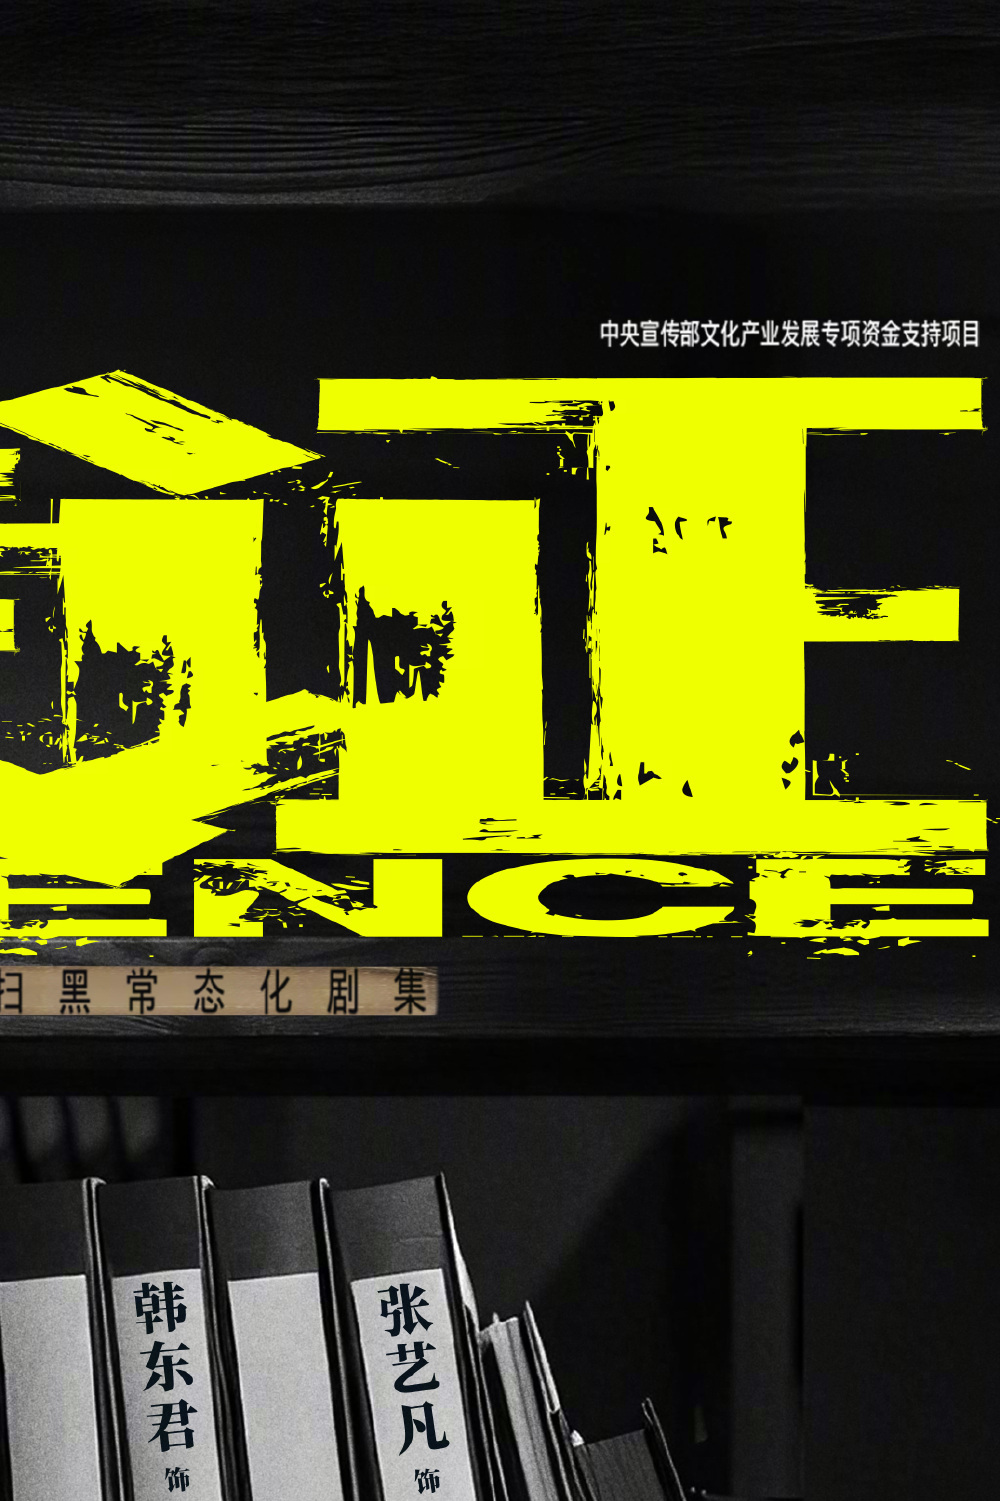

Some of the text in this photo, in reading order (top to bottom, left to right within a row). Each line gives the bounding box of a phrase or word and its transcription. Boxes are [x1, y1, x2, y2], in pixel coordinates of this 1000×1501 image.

[600, 319, 980, 348] 中央宣传部文化产业发展专项资金支持项目
[131, 1282, 197, 1454] 韩东君
[165, 1467, 189, 1492] 饰
[375, 1281, 452, 1458] 张艺凡
[415, 1469, 439, 1494] 饰
